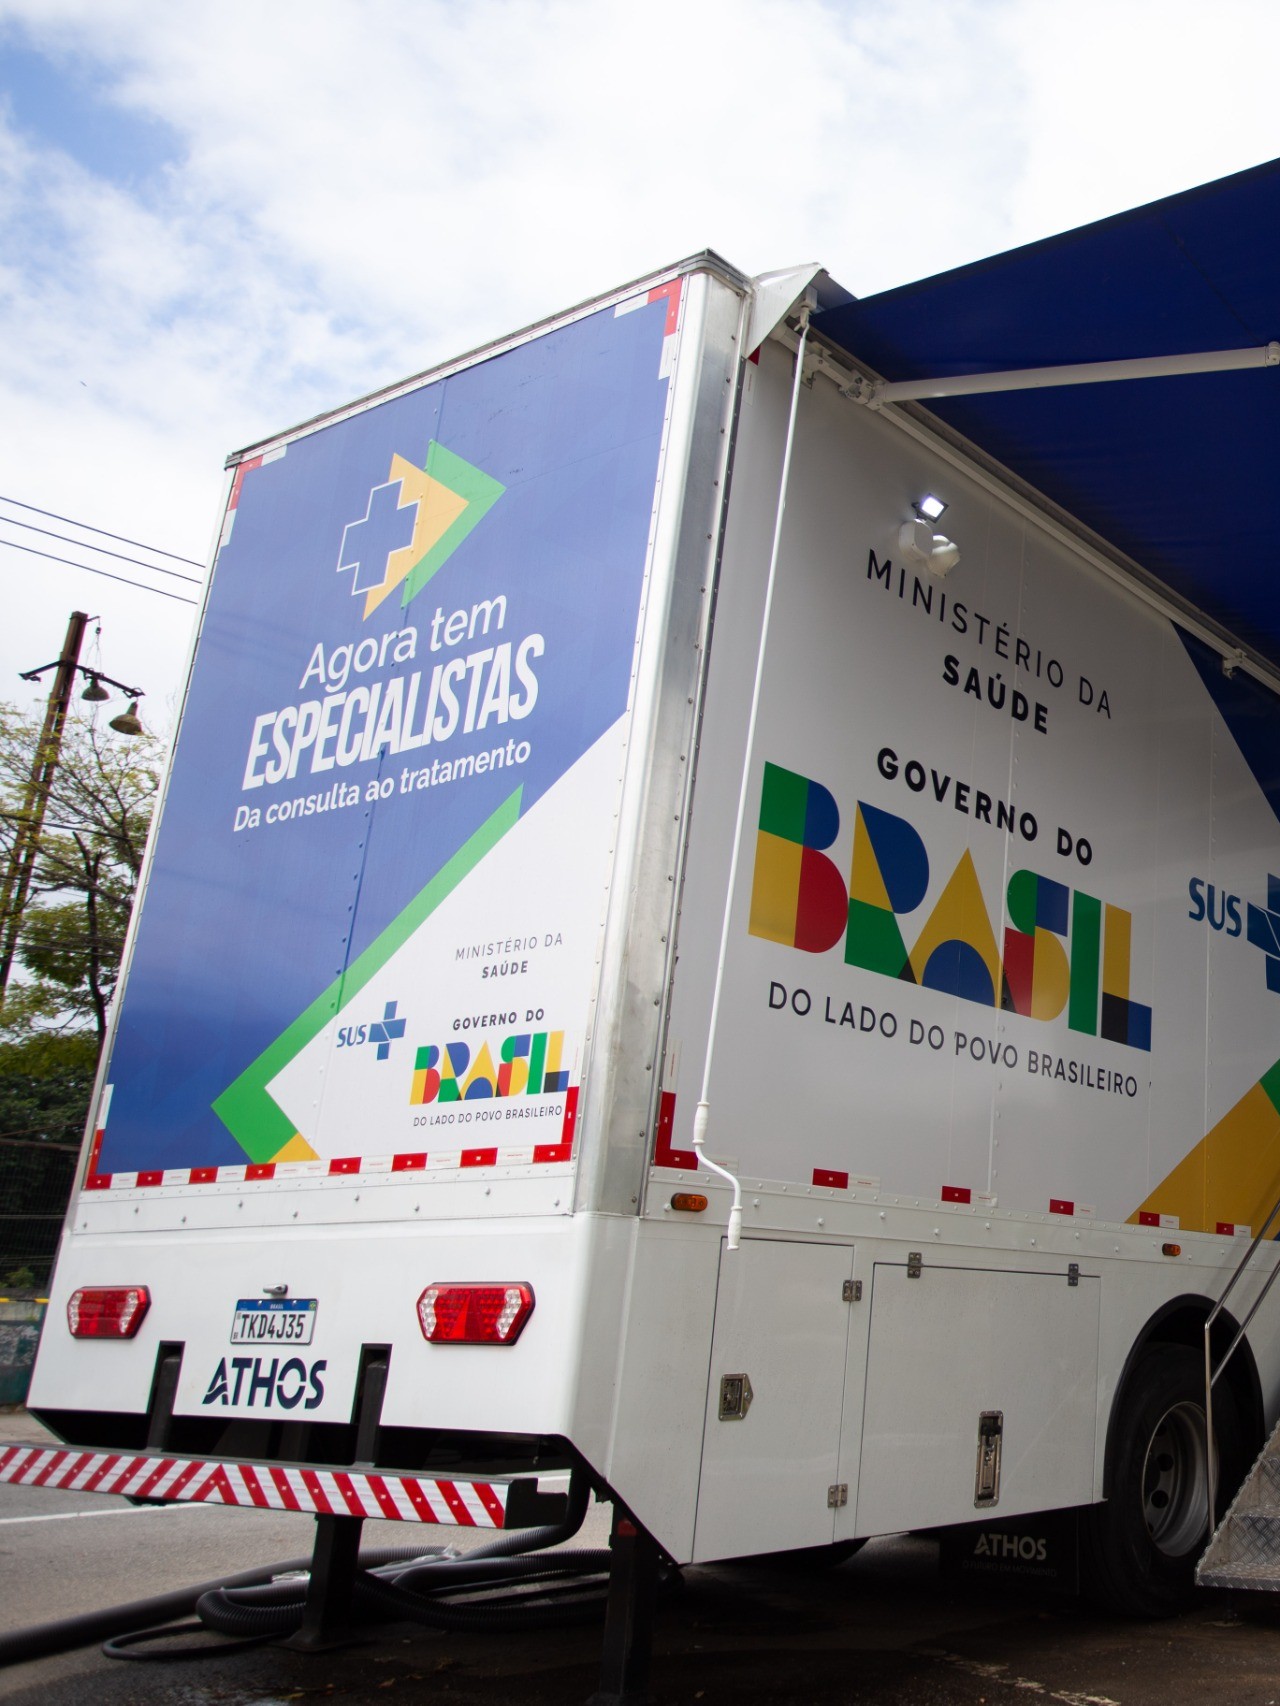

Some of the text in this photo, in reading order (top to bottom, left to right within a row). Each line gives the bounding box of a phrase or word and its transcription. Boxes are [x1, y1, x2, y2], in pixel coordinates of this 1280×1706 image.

[299, 594, 507, 693] Agora tem
[867, 549, 1111, 719] MINISTÉRIO DA
[241, 633, 545, 791] ESPECIALISTAS
[942, 654, 1048, 735] SAÚDE
[233, 738, 531, 832] Da consulta ao tratamento
[877, 747, 1093, 866] GOVERNO DO
[748, 761, 1153, 1052] BRASIL
[1188, 876, 1242, 938] SUS
[455, 932, 563, 961] MINISTÉRIO DA
[481, 960, 529, 979] SAÚDE
[336, 1024, 367, 1048] SUS
[452, 1008, 545, 1031] GOVERNO DO
[768, 981, 1138, 1097] DO LADO DO POVO BRASILEIRO
[409, 1030, 570, 1105] BRASIL
[413, 1105, 563, 1127] DO LADO DO POVO BRASILEIRO
[240, 1314, 306, 1339] TKD4J35
[202, 1357, 328, 1410] ATHOS
[974, 1533, 1047, 1561] ATHOS
